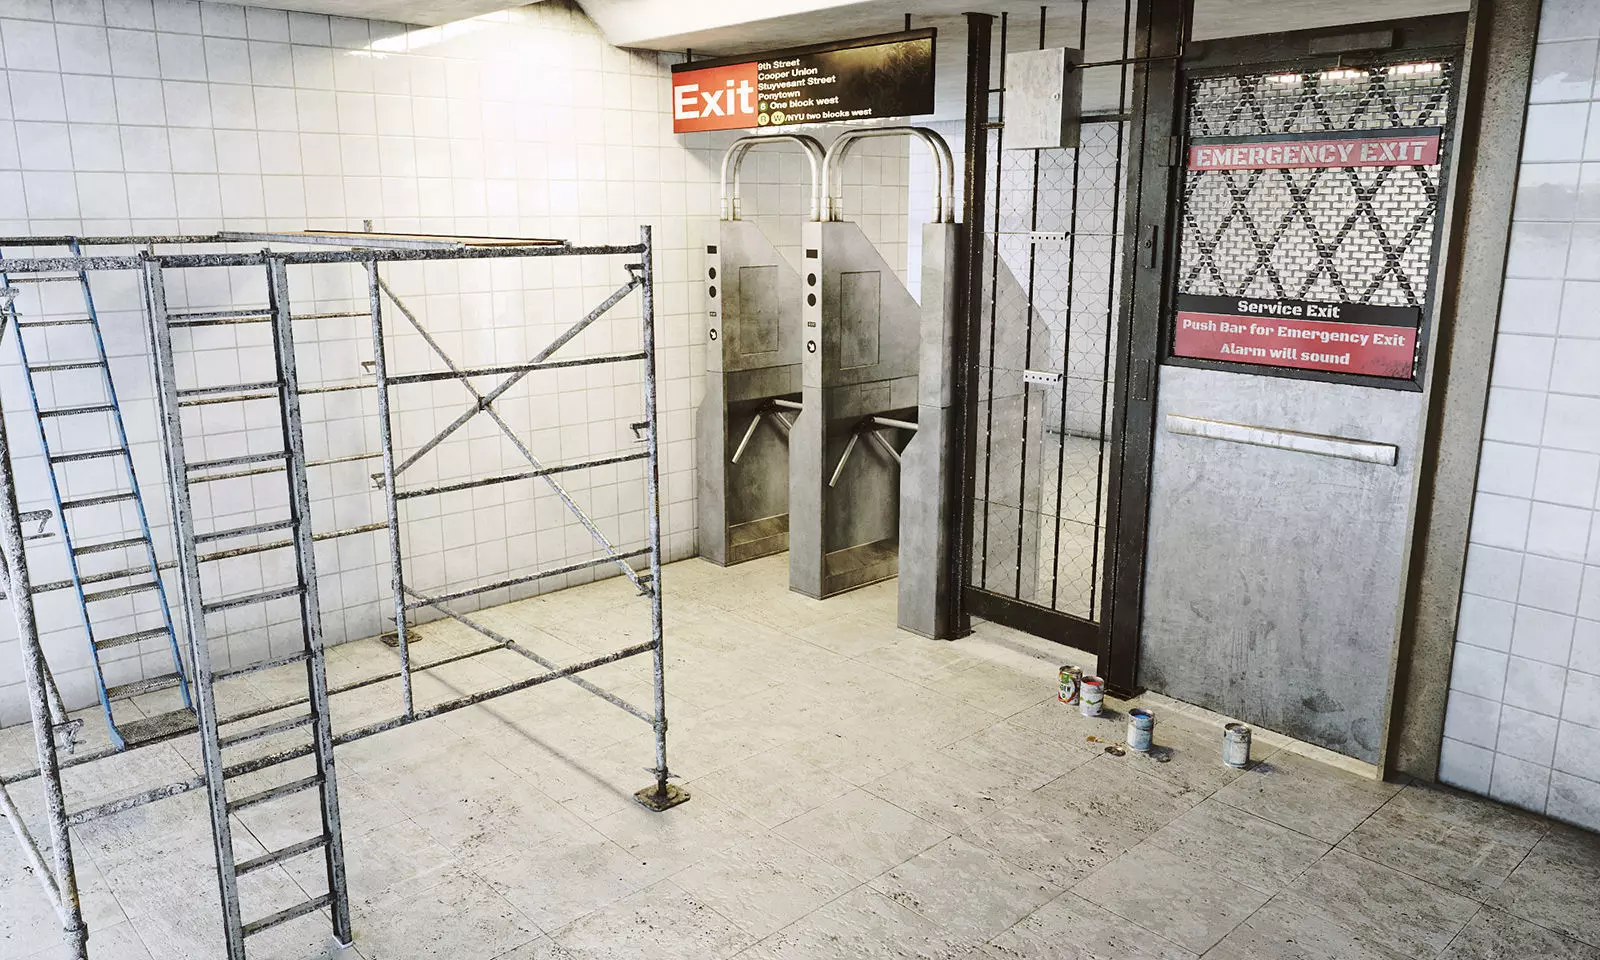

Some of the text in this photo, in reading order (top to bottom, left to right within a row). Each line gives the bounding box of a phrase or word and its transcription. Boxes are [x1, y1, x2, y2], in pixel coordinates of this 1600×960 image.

[758, 58, 800, 70] 9th Street
[758, 68, 818, 80] Cooper Union
[758, 74, 836, 90] Stuyvesant Street
[674, 79, 754, 120] Exit
[758, 90, 800, 100] Ponytown
[770, 101, 787, 109] One
[789, 98, 814, 108] block
[816, 96, 839, 105] west
[822, 109, 849, 119] blocks
[851, 108, 872, 116] west
[1196, 141, 1428, 167] EMERGENCY EXIT
[1238, 300, 1340, 319] Service Exit
[1183, 319, 1405, 347] Push Bar for Emergency Exit
[1220, 343, 1350, 365] Alarm will sound
